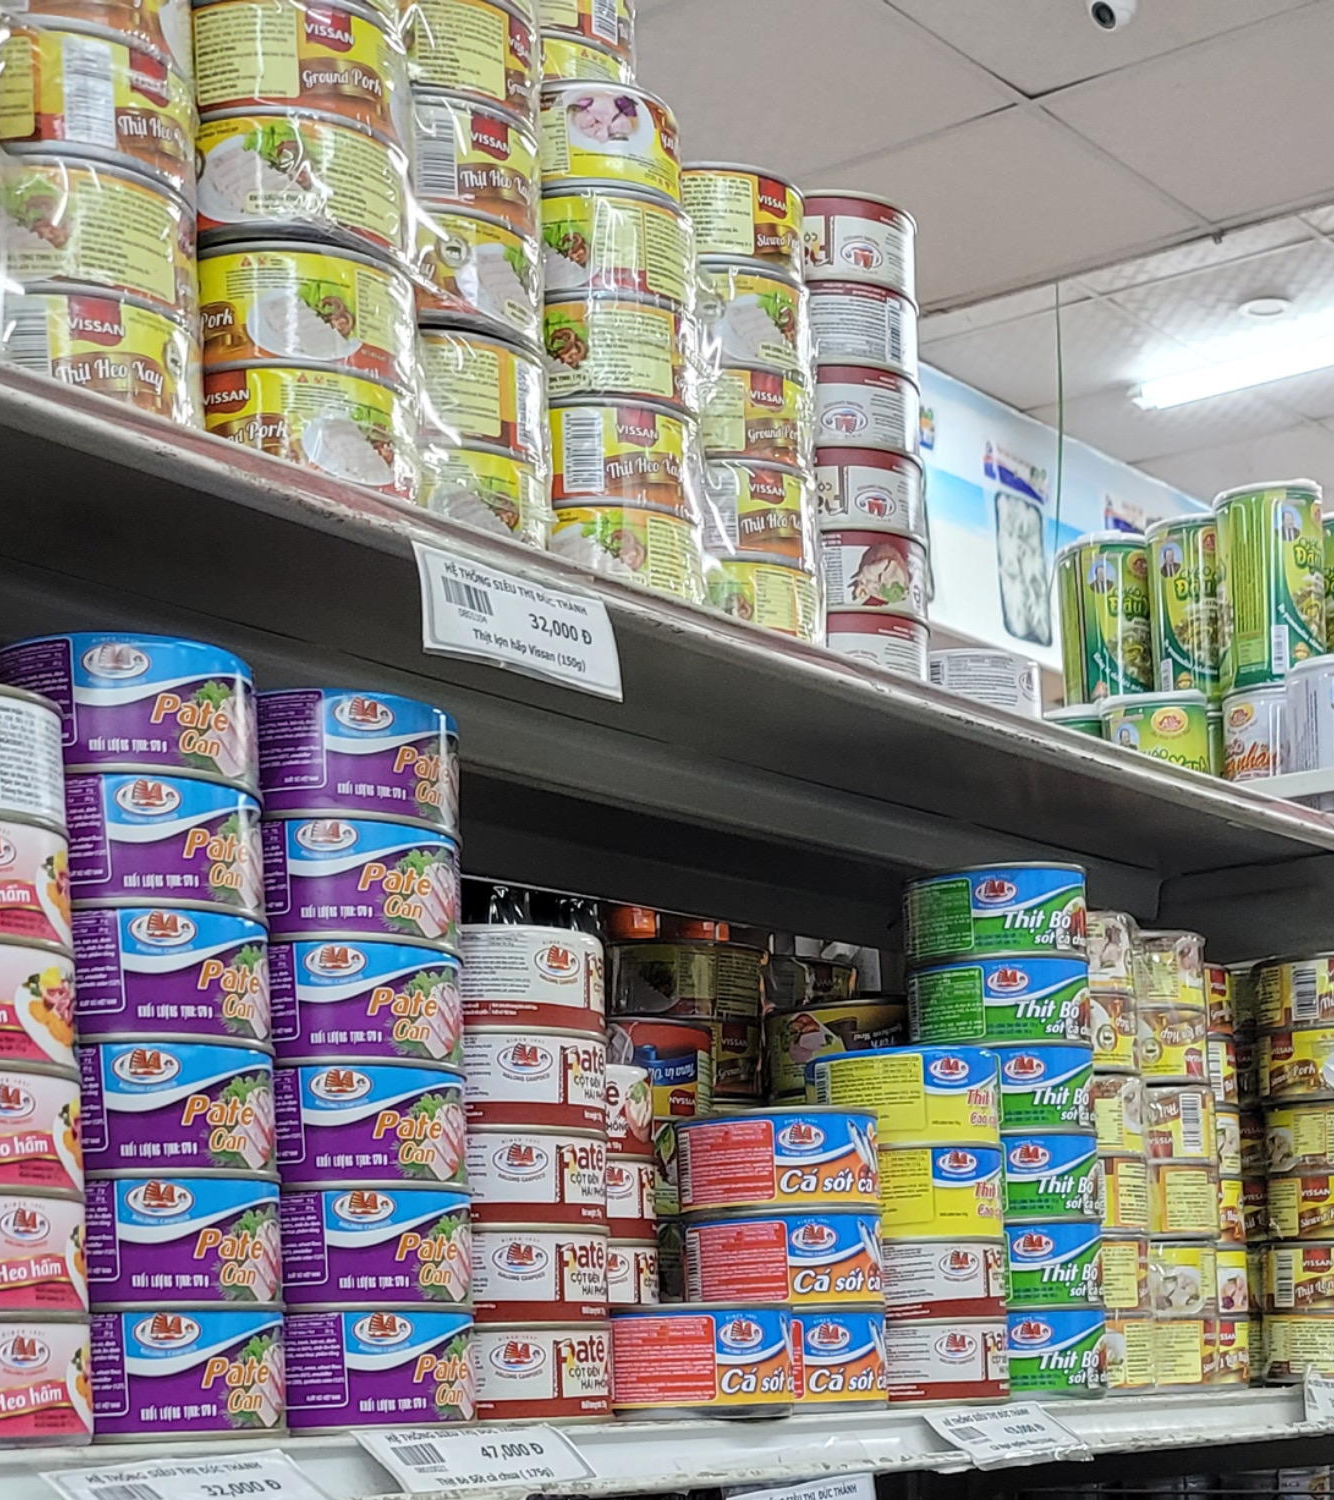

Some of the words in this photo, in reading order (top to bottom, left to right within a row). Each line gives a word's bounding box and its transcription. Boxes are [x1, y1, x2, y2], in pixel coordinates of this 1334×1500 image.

[304, 22, 354, 45] VISSAN
[302, 70, 349, 87] Ground
[351, 67, 382, 95] Pork
[68, 317, 125, 337] VISSAN
[94, 361, 129, 381] Heo
[132, 359, 164, 395] Xay
[529, 613, 579, 641] 32,000
[581, 629, 593, 645] Đ
[473, 628, 493, 645] Thịt
[495, 634, 509, 649] lợn
[510, 637, 527, 655] hấp
[529, 644, 556, 662] Vissan
[558, 652, 586, 673] (150g)
[150, 694, 231, 735] Pate
[1003, 908, 1046, 932] Thịt
[779, 1166, 819, 1194] Cá
[823, 1164, 854, 1191] sốt
[201, 1481, 265, 1498] 32,000
[267, 1479, 282, 1491] Đ
